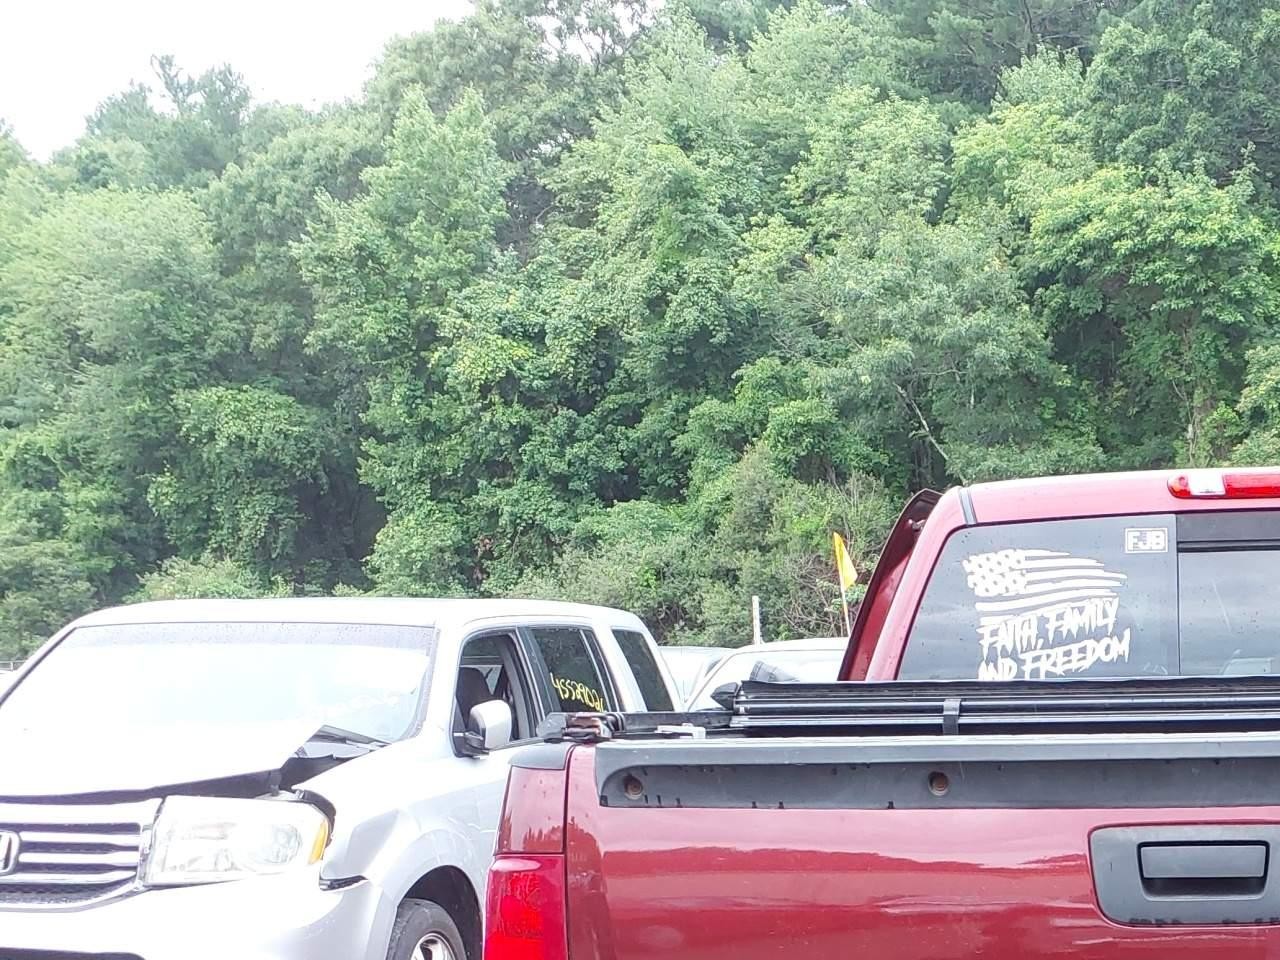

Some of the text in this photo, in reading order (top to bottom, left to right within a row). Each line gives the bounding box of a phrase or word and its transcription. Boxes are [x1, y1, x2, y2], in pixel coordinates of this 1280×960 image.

[1126, 530, 1166, 551] FJB
[976, 597, 1120, 661] FAITH, FAMILY
[976, 628, 1131, 681] AND FREEDOM
